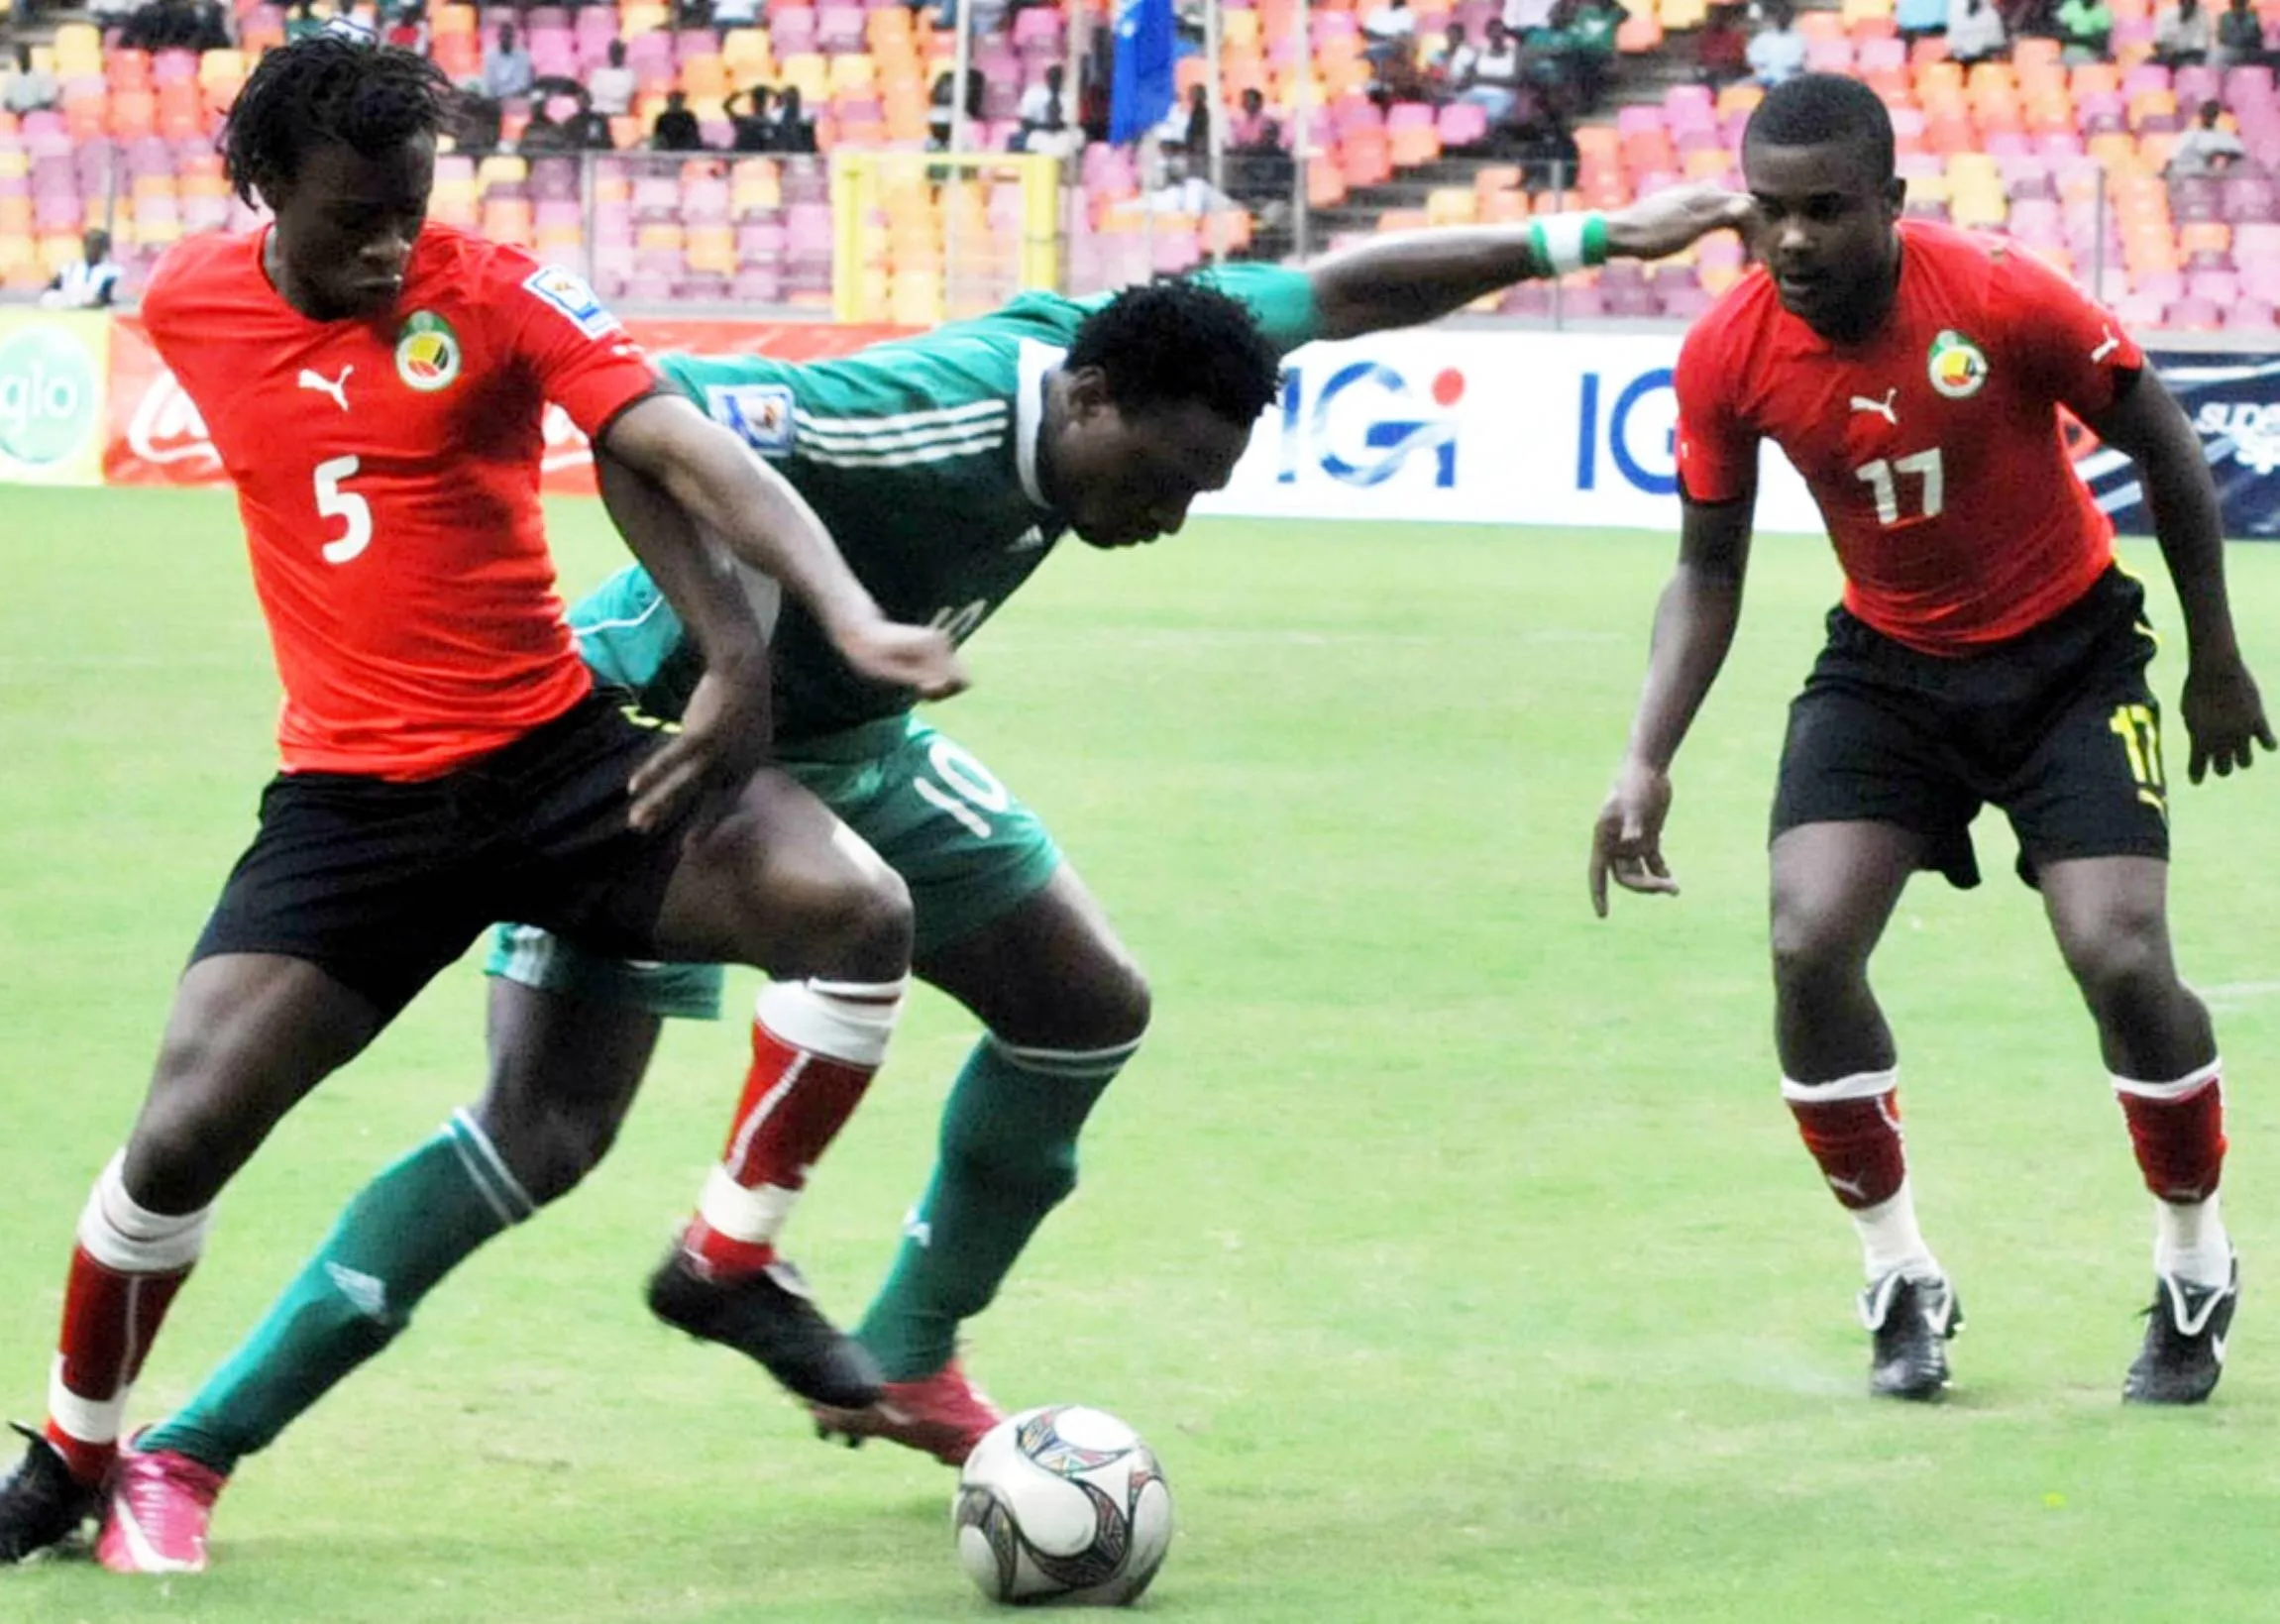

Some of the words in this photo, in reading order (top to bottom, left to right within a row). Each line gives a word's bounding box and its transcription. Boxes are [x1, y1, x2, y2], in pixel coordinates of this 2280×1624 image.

[0, 359, 77, 437] glo
[1575, 368, 1683, 495] IG
[313, 454, 374, 564] 5
[1855, 447, 1942, 525] 17
[913, 739, 1010, 839] 10
[2109, 703, 2161, 786] 17
